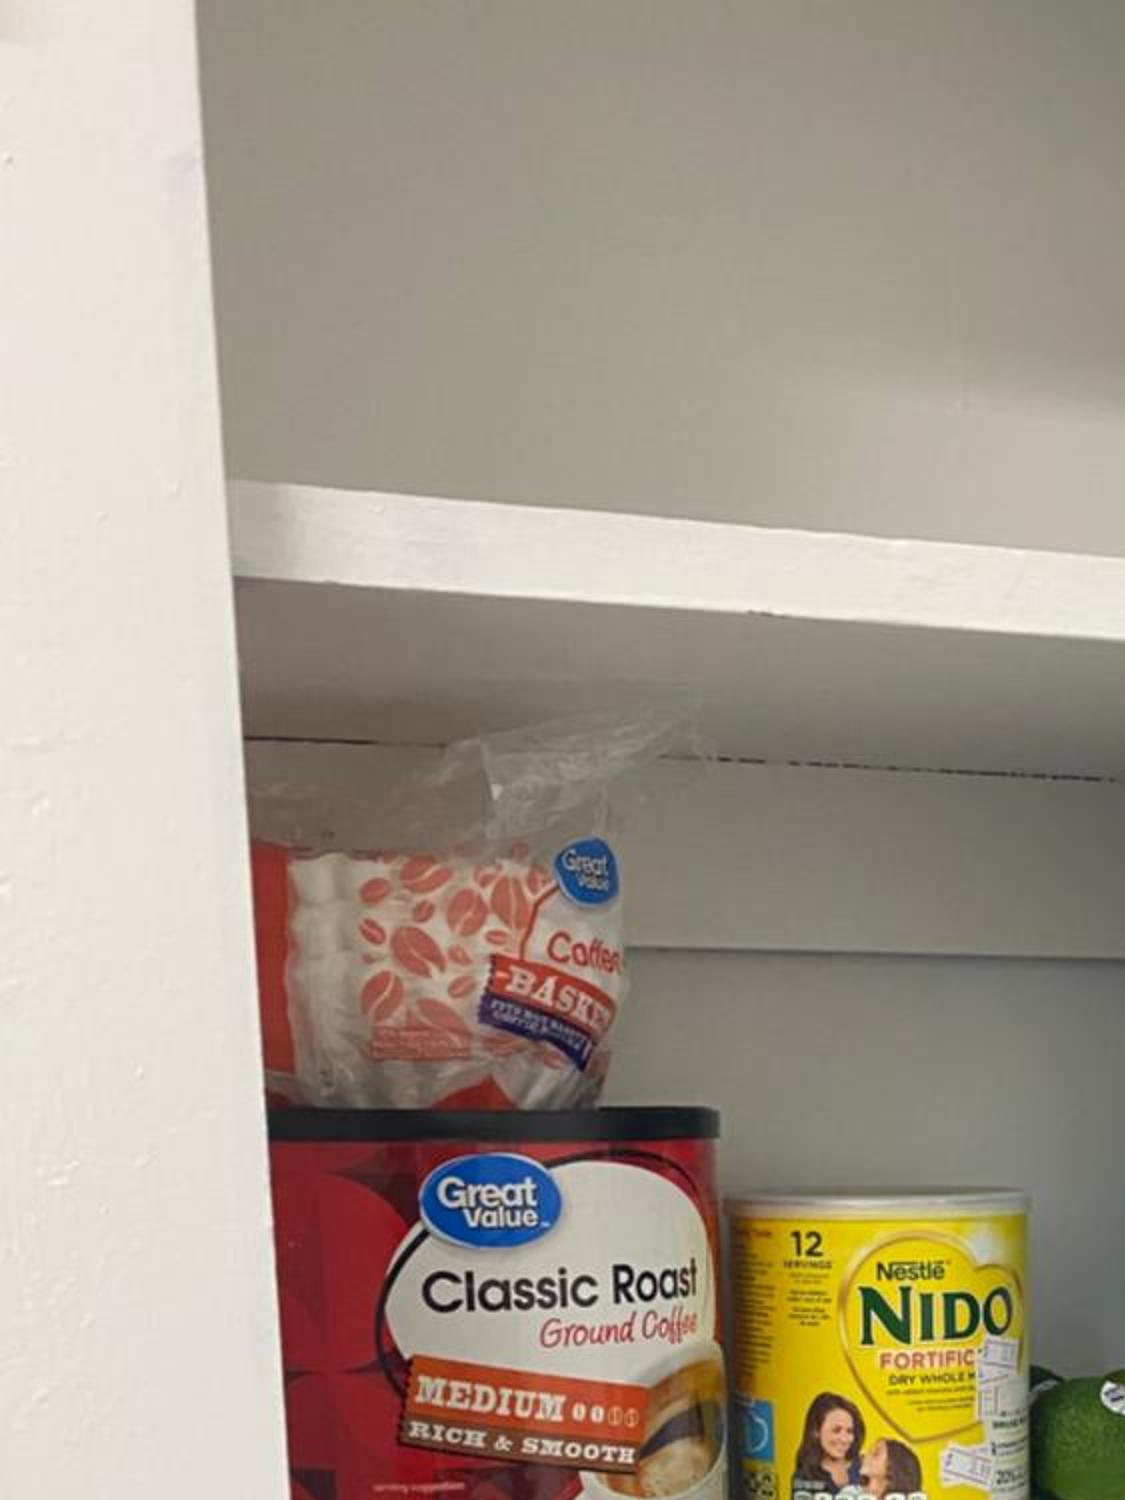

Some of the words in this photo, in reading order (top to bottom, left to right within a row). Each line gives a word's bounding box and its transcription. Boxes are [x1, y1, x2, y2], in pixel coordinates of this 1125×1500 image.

[561, 848, 609, 876] Great
[436, 1175, 537, 1209] Great
[464, 1206, 538, 1229] Value
[791, 1231, 824, 1257] 12
[421, 1267, 599, 1313] Classic
[612, 1258, 698, 1305] Roast
[540, 1313, 635, 1349] Ground
[641, 1305, 698, 1345] Coffee
[858, 1285, 1014, 1346] NIDO
[921, 1371, 965, 1385] WHOLE
[414, 1374, 567, 1422] MEDIUM
[406, 1421, 487, 1449] RICH
[493, 1434, 514, 1453] &
[521, 1437, 637, 1465] SMOOTH
